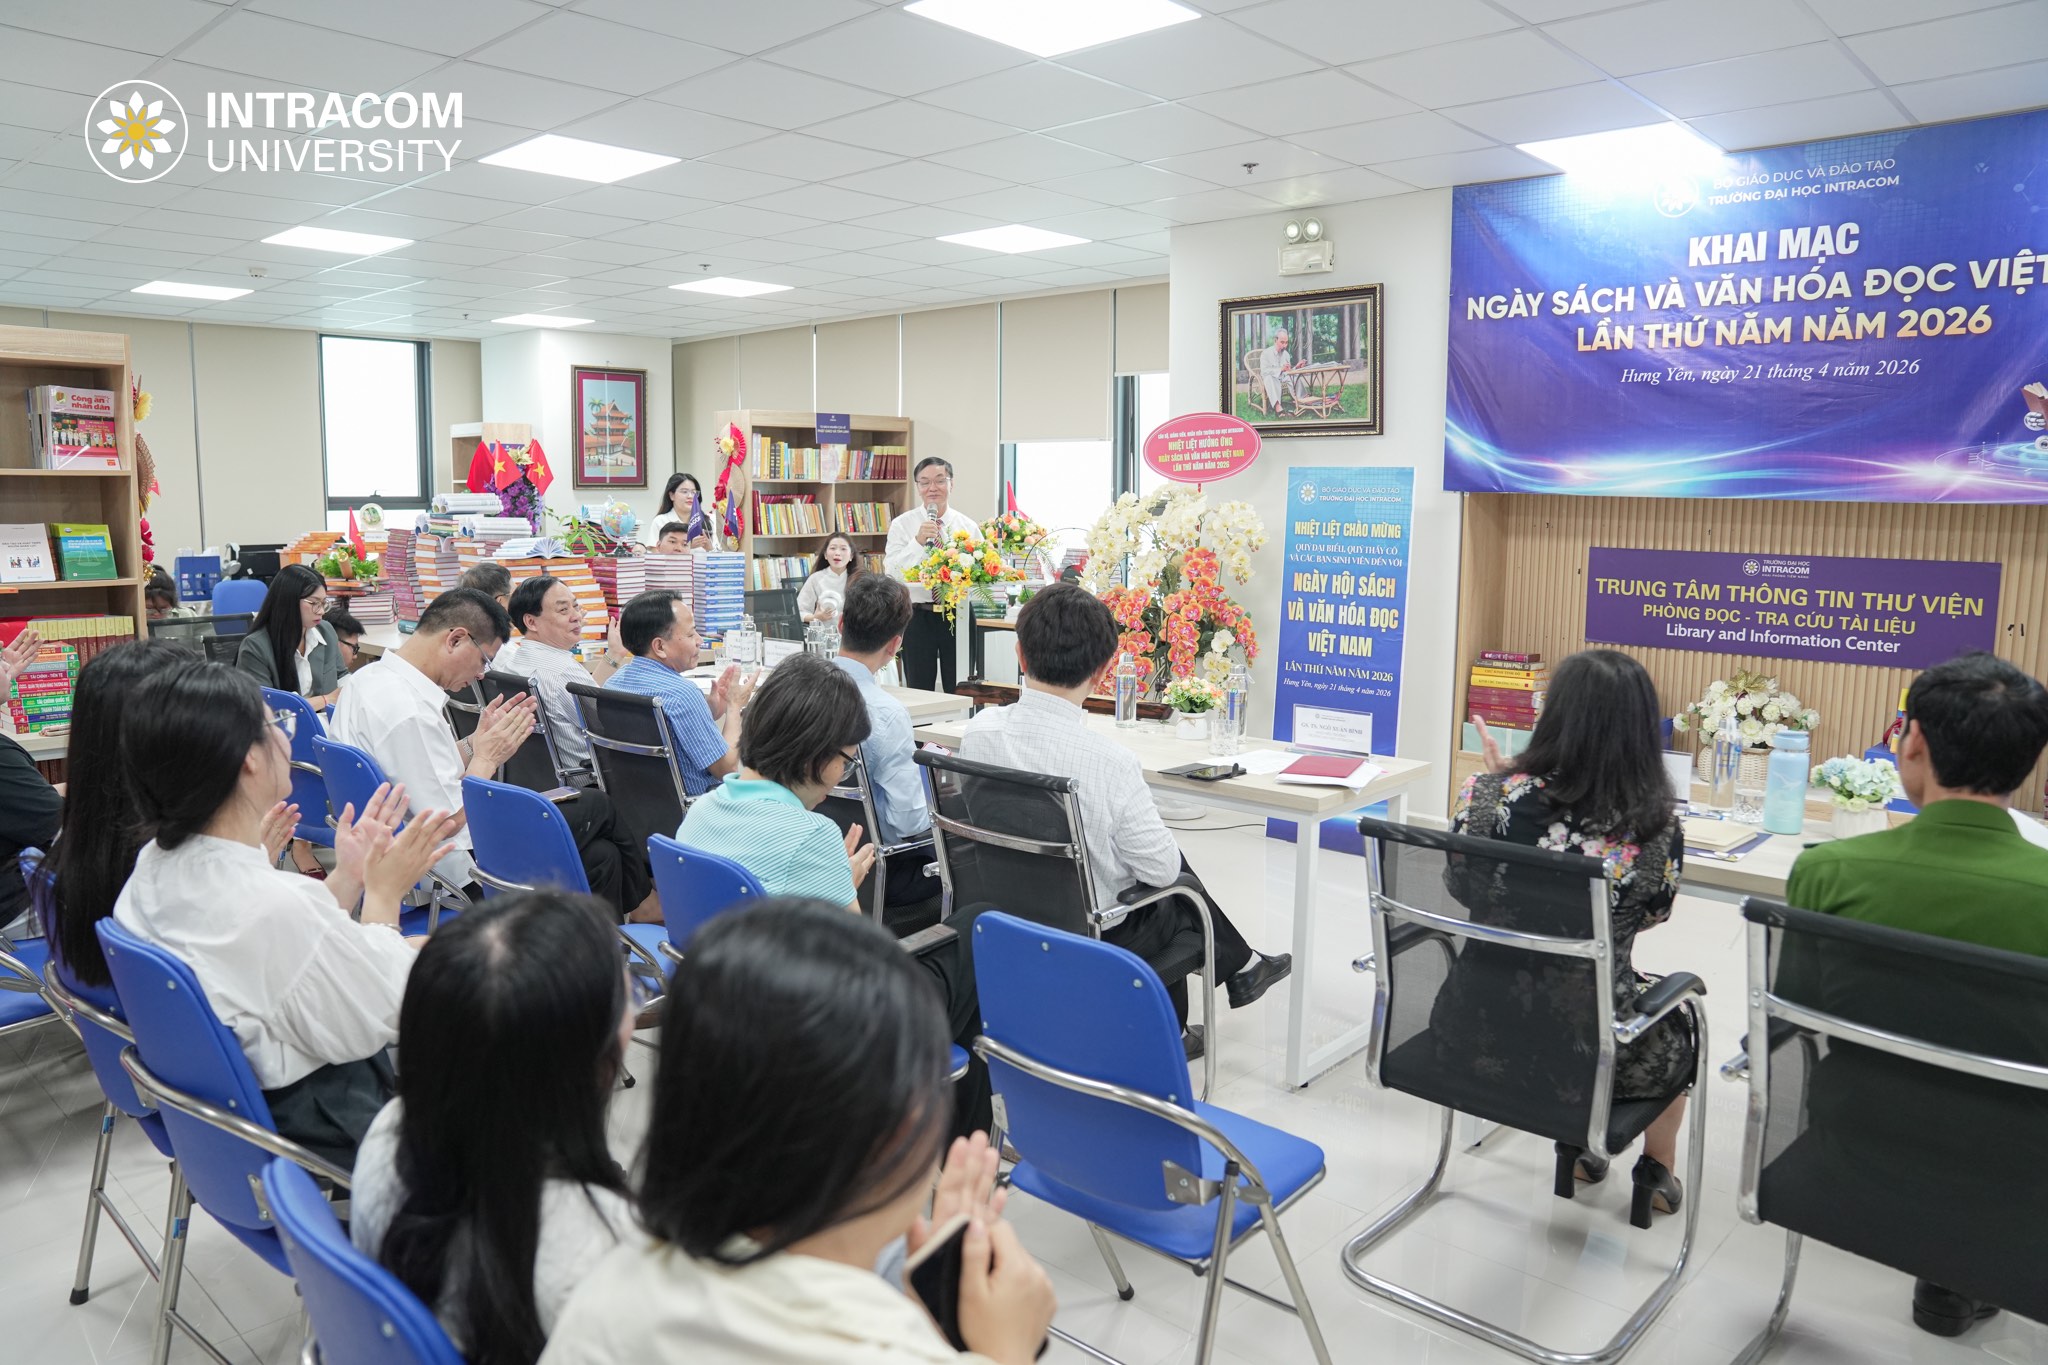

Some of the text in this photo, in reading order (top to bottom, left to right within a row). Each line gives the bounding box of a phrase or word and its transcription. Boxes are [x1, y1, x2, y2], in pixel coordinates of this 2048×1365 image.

[1736, 174, 1769, 186] GIÁO
[1773, 170, 1803, 183] DỤC
[1807, 165, 1825, 179] VÀ
[1829, 162, 1861, 176] ĐÀO
[1866, 159, 1895, 172] TẠO
[1709, 176, 1900, 206] TRƯỜNG ĐẠI HỌC INTRACOM
[1688, 222, 1859, 267] KHAI MẠC
[1467, 288, 1544, 320] NGÀY
[1552, 283, 1635, 315] SÁCH
[1644, 277, 1685, 309] VÀ
[1695, 273, 1762, 306] VĂN
[1773, 266, 1852, 302] HÓA
[1864, 263, 1957, 303] ĐỌC
[1578, 305, 1992, 351] LẦN THỨ NĂM NĂM 2026
[1621, 359, 1921, 385] Hưng Yên, ngày 21 tháng 4 năm 2026
[72, 395, 92, 404] Công
[1168, 436, 1232, 451] NHIỆT LIỆT HƯỞNG ỨNG
[1171, 452, 1183, 461] SÁCH
[1184, 452, 1190, 461] VÀ
[1222, 449, 1231, 459] VIỆT
[1217, 460, 1229, 468] 2026
[1295, 519, 1401, 539] NHIỆT LIỆT CHÀO MỪNG
[1300, 554, 1315, 562] CÁC
[1316, 556, 1331, 565] BẠN
[1332, 556, 1350, 564] SINH
[1352, 556, 1370, 565] VIÊN
[1371, 556, 1387, 566] ĐẾN
[1388, 558, 1402, 567] VỚI
[1312, 544, 1324, 552] ĐẠI
[1386, 546, 1397, 555] CÔ
[1762, 566, 1810, 574] INTRACOM
[1294, 569, 1396, 599] NGÀY HỘI SÁCH
[1596, 578, 1983, 619] TRUNG TÂM THÔNG TIN THƯ VIỆN
[1288, 597, 1399, 632] VÀ VĂN HÓA ĐỌC
[1643, 602, 1700, 620] PHÒNG
[1705, 608, 1740, 624] ĐỌC
[1755, 611, 1789, 626] TRA
[1794, 611, 1834, 629] CỨU
[1839, 614, 1868, 631] TÀI
[1874, 616, 1916, 636] LIỆU
[1308, 629, 1372, 657] VIỆT NAM
[1666, 623, 1900, 652] Library and Information Center
[1285, 660, 1393, 682] LẦN THỨ NĂM NĂM 2026
[1338, 685, 1355, 694] tháng
